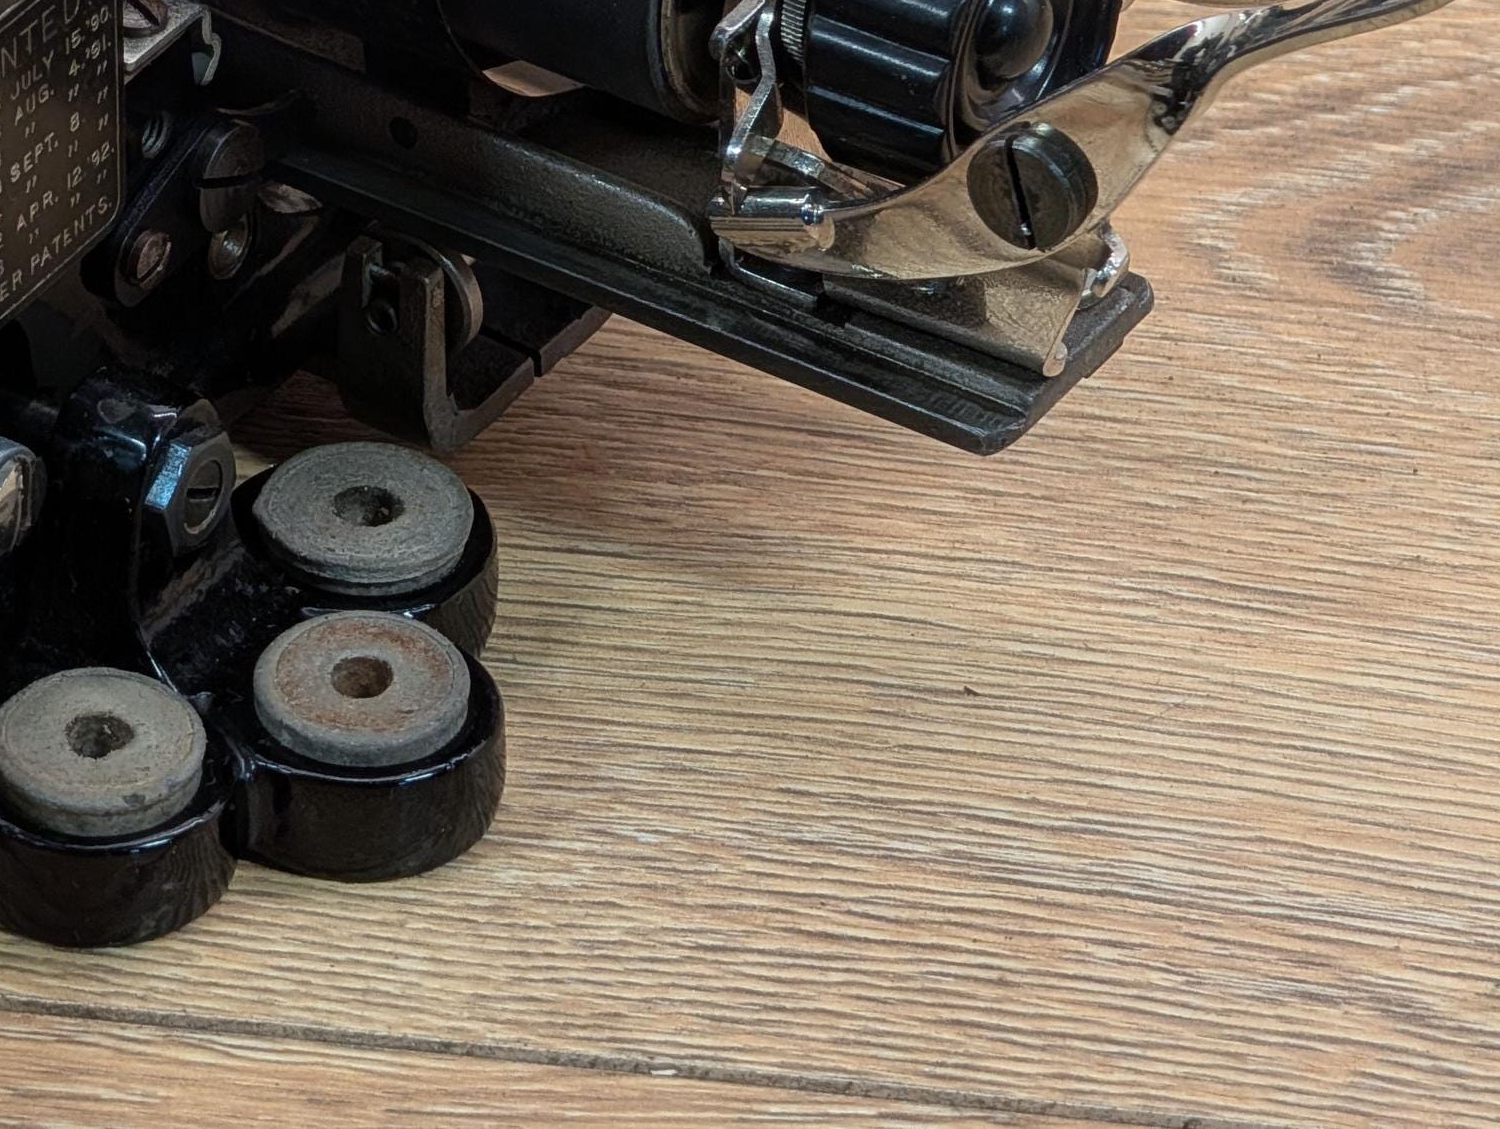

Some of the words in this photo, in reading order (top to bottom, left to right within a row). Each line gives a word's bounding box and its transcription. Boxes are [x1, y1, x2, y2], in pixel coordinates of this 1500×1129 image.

[10, 49, 54, 101] JULY
[15, 84, 54, 126] AUG.
[10, 132, 59, 184] SEPT.
[17, 191, 59, 231] APR.
[30, 196, 113, 274] PATENTS.
